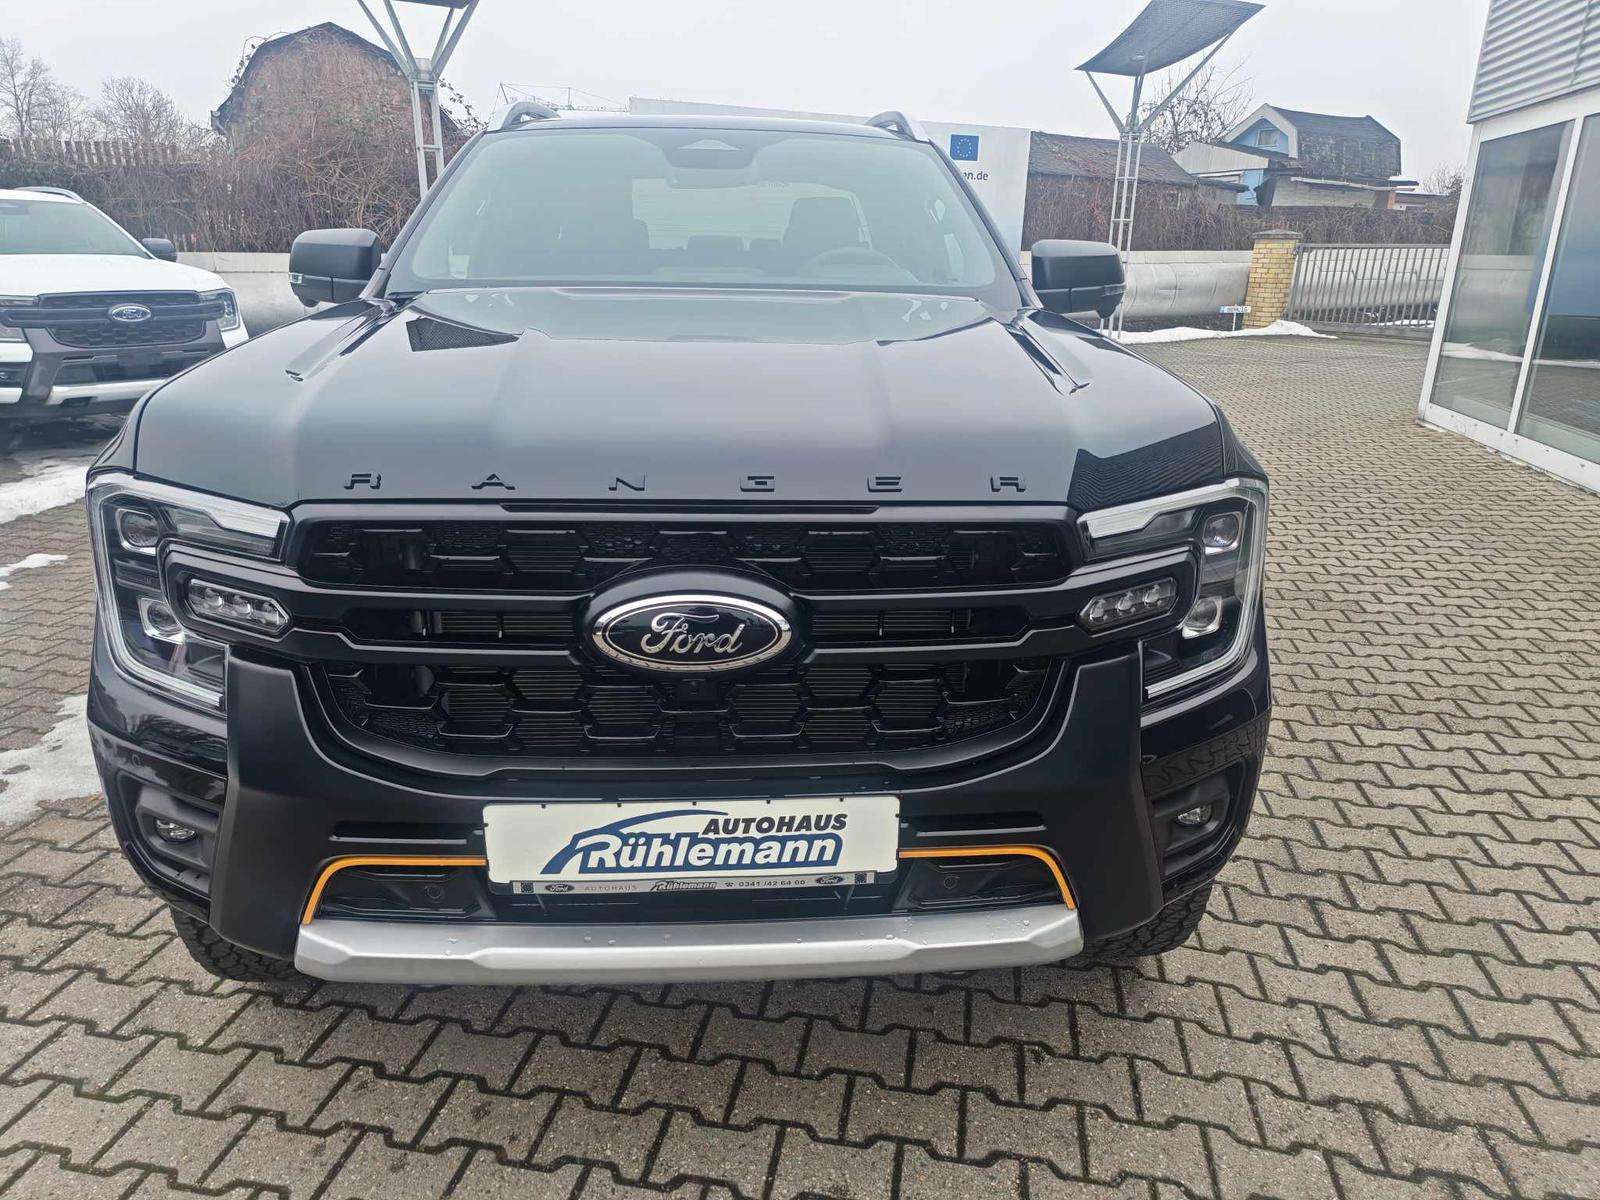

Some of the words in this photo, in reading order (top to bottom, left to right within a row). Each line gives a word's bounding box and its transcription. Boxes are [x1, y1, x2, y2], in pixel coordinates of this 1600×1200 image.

[343, 472, 1027, 493] RANGER
[640, 611, 746, 654] Ford
[703, 813, 848, 835] AUTOHAUS
[575, 833, 836, 868] Rühlemann
[584, 884, 637, 892] AUTOHAUS
[738, 880, 760, 888] 0341
[780, 879, 792, 887] 64
